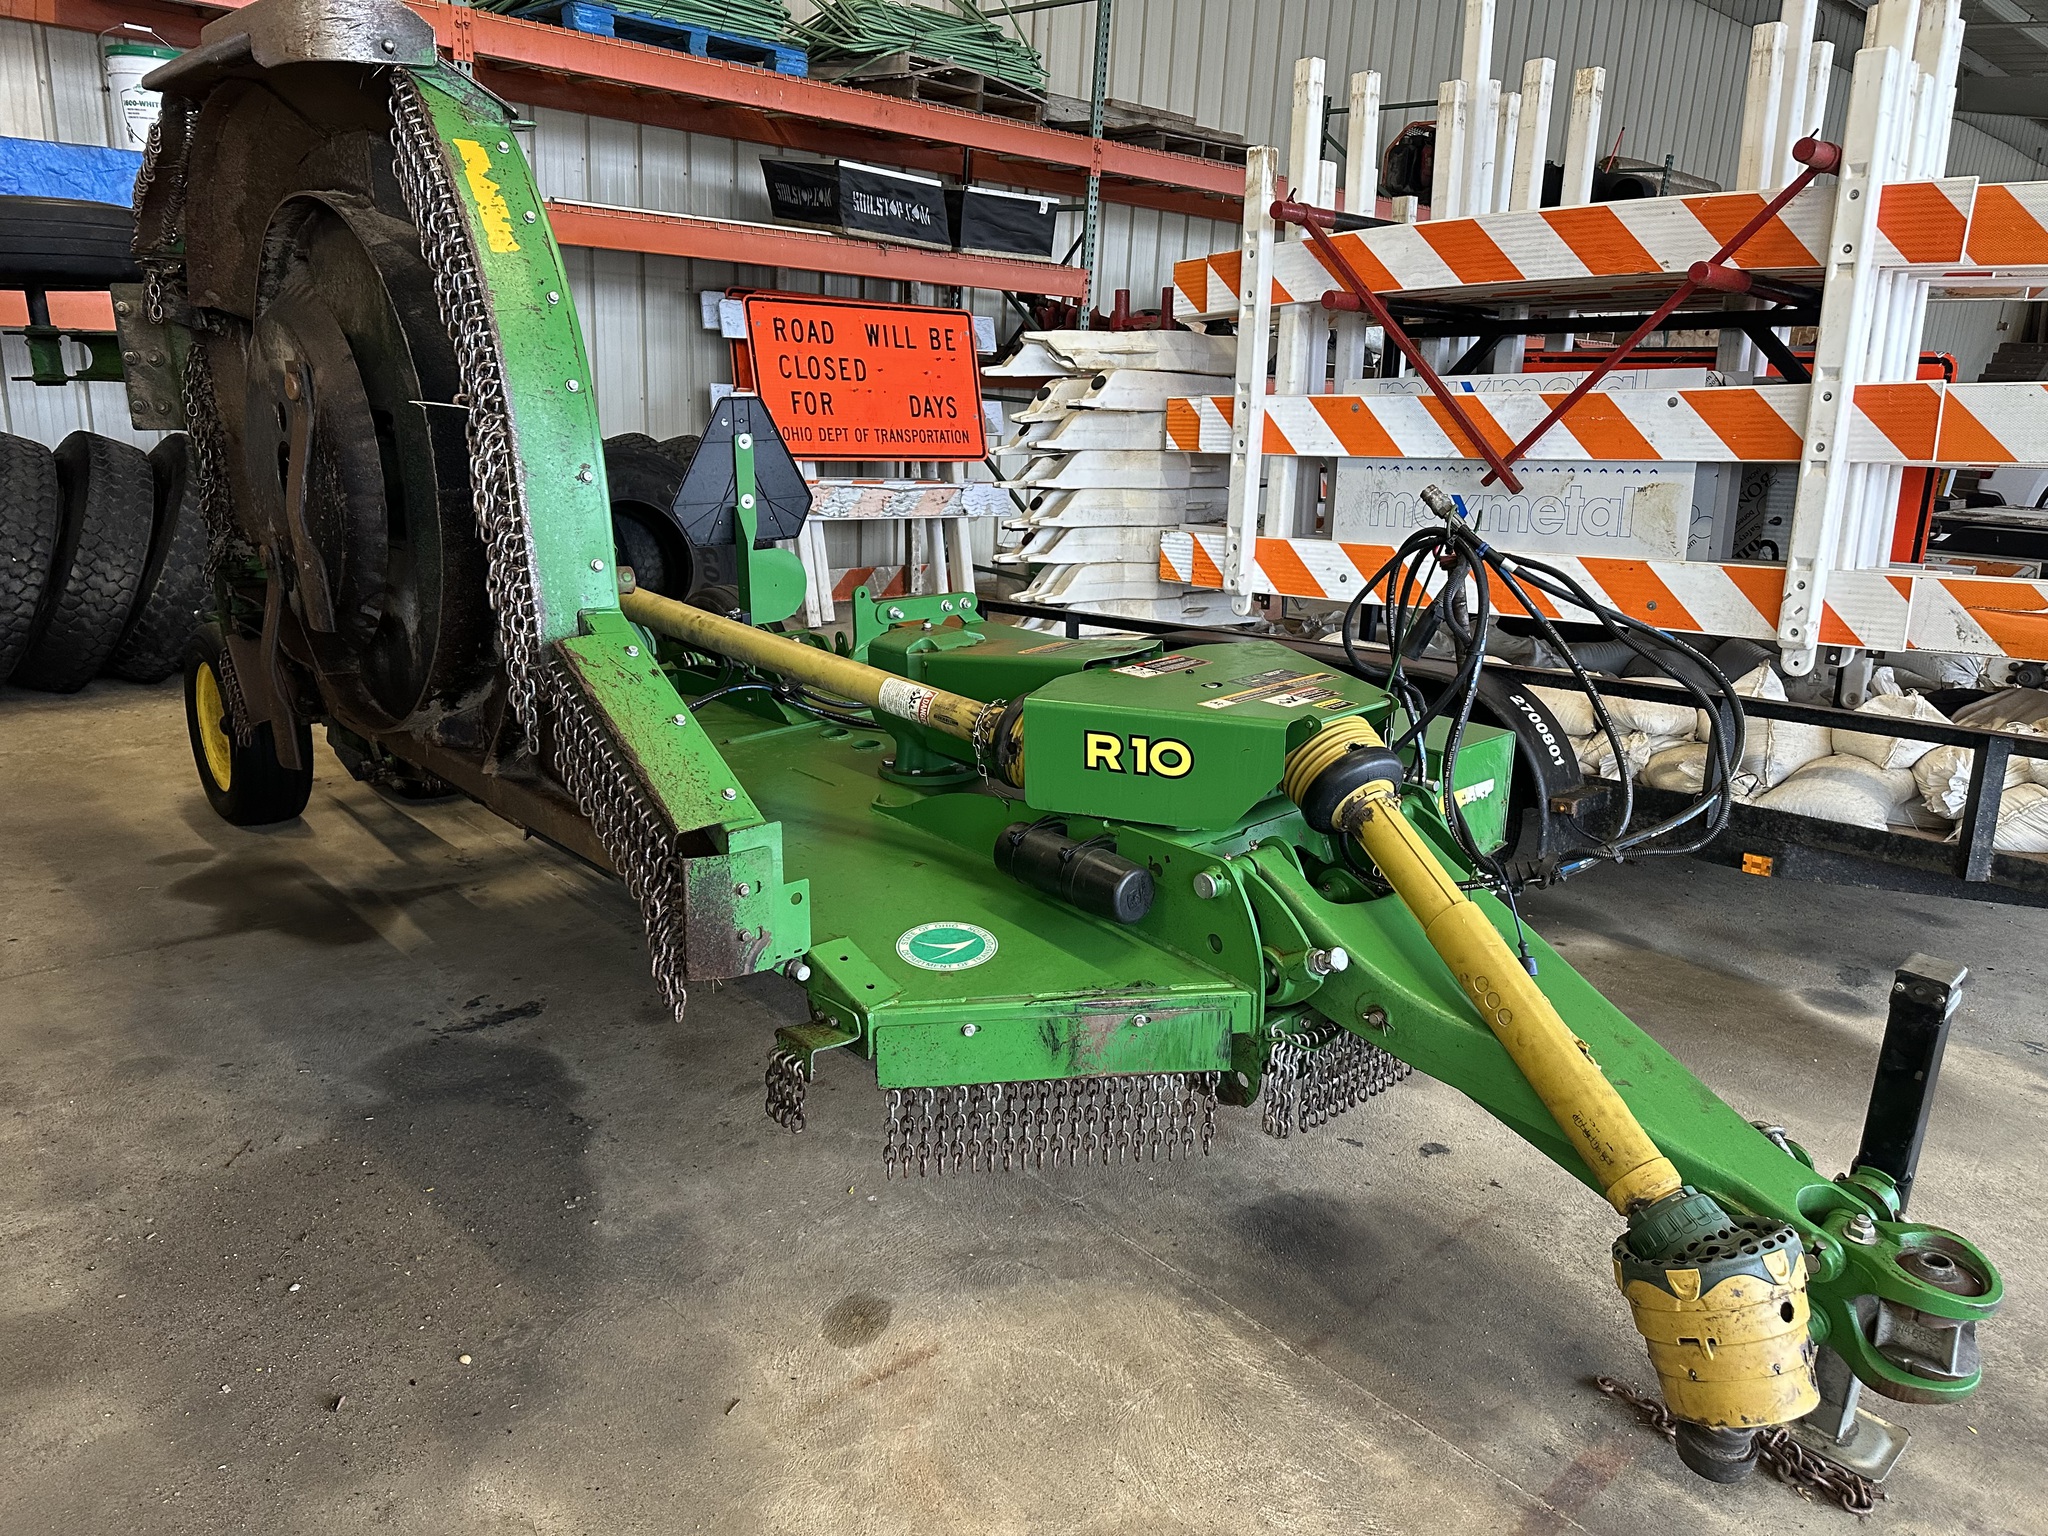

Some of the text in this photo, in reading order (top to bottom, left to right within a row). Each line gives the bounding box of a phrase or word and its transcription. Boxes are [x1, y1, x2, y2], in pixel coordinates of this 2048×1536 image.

[773, 316, 956, 351] ROAD WILL BE
[778, 354, 867, 381] CLOSED
[791, 391, 958, 419] FOR DAYS
[782, 426, 970, 444] OHIO DEPT OF TRANSPORTATION
[1509, 695, 1566, 766] 2700801
[901, 931, 917, 946] STATE
[901, 949, 953, 969] DEPARTMENT
[967, 926, 994, 964] TRANSPORTATION
